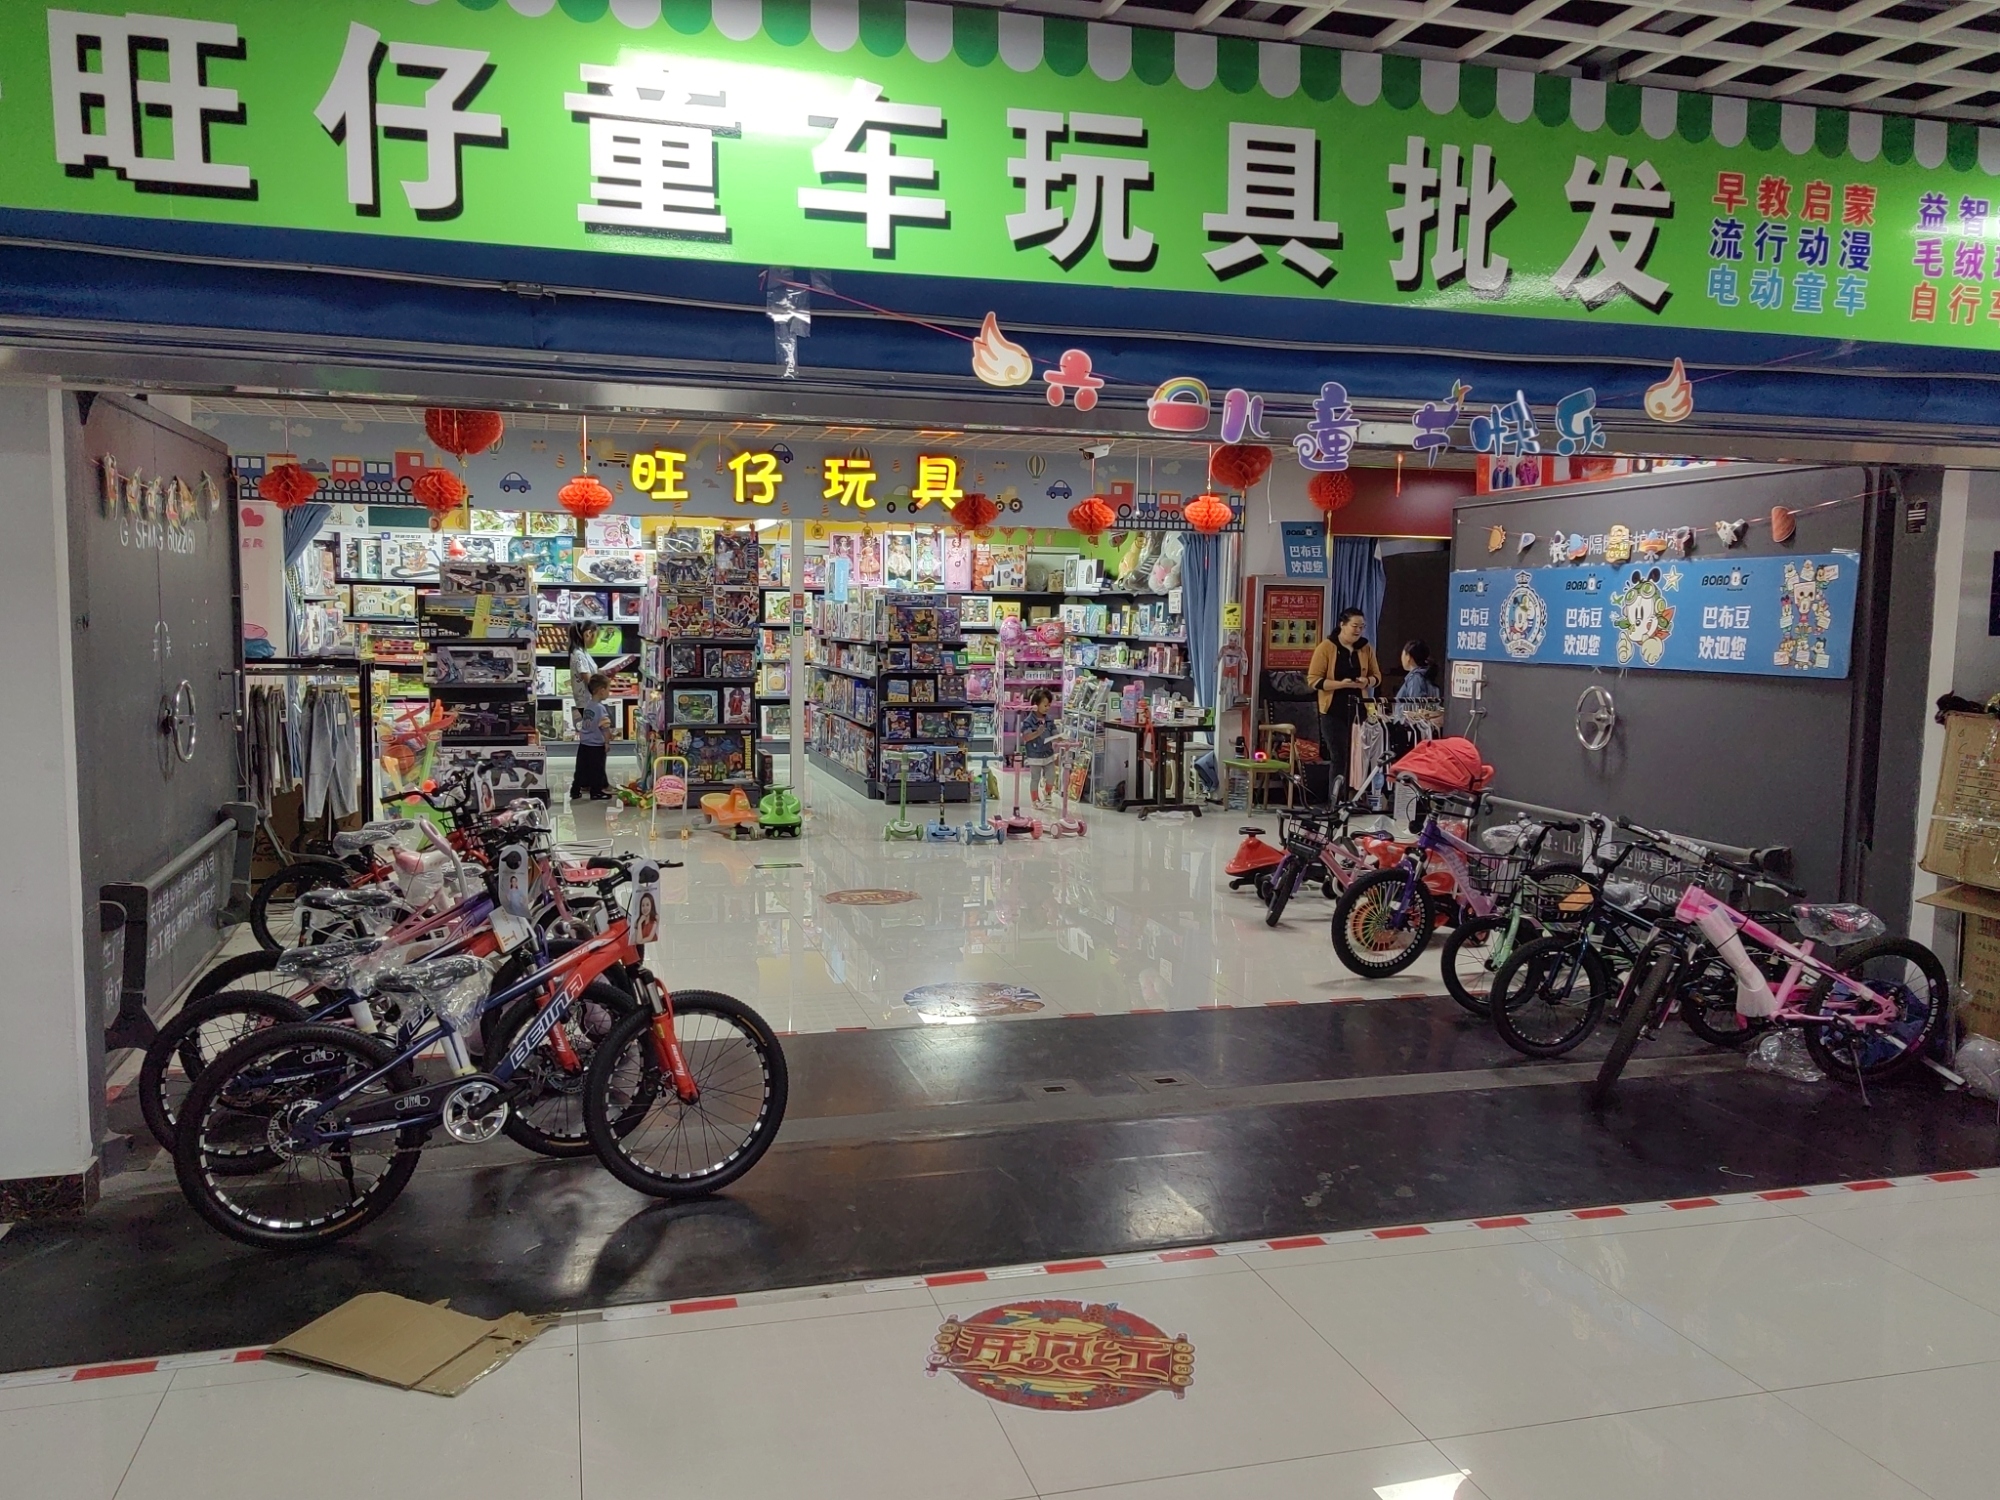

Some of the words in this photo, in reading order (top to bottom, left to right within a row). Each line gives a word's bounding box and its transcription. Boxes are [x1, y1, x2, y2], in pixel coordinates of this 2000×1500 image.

[47, 8, 1674, 314] 旺仔童车玩具批发
[1713, 171, 1877, 226] 早教启蒙
[1914, 190, 2000, 238] 益智
[1709, 217, 1872, 272] 流行动漫
[1913, 237, 2000, 282] 毛绒
[1707, 263, 1867, 317] 电动童车
[631, 450, 964, 510] 旺仔玩具
[1290, 545, 1322, 558] 巴布豆
[1291, 561, 1324, 573] 欢迎您
[1460, 608, 1489, 626] 巴布豆
[1565, 607, 1603, 628] 巴布豆
[1702, 605, 1751, 629] 巴布豆
[1457, 631, 1487, 650] 欢迎您
[1563, 634, 1601, 656] 欢迎您
[1698, 636, 1747, 660] 欢迎您
